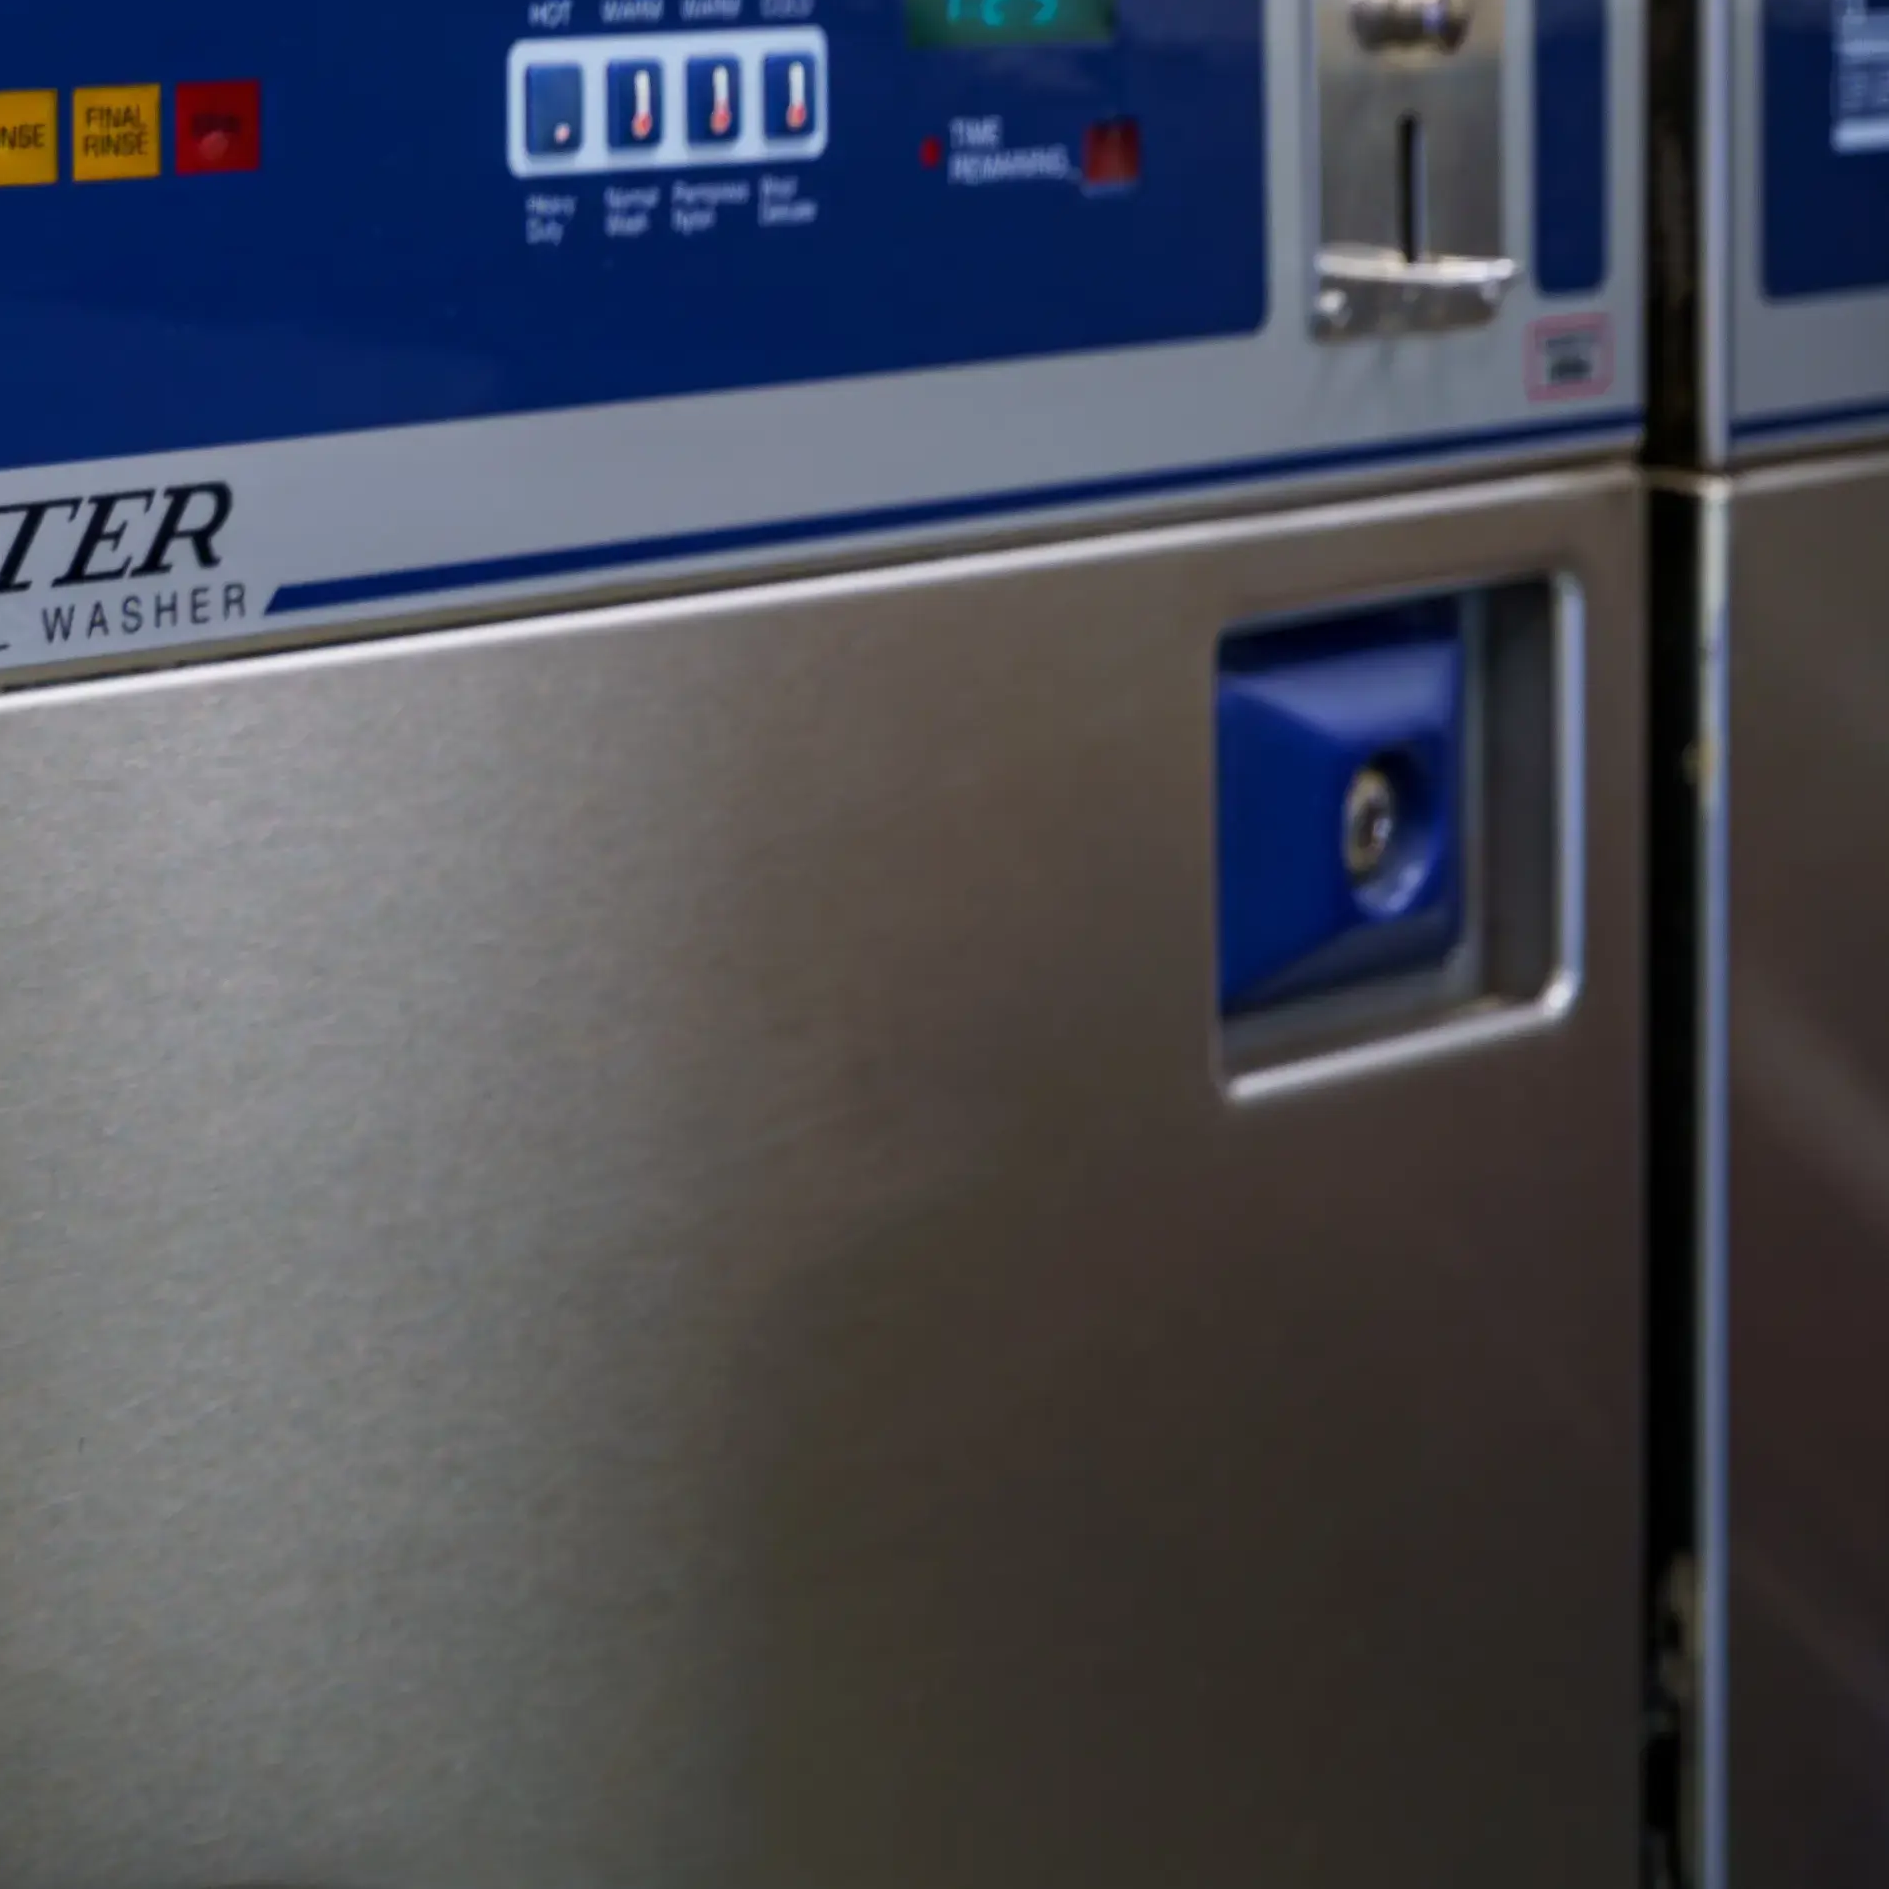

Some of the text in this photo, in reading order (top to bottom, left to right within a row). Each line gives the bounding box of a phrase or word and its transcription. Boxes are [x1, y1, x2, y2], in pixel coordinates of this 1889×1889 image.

[528, 0, 572, 27] HOT
[86, 104, 143, 128] FINAL
[83, 131, 149, 158] RINSE
[42, 582, 246, 645] WASHER
